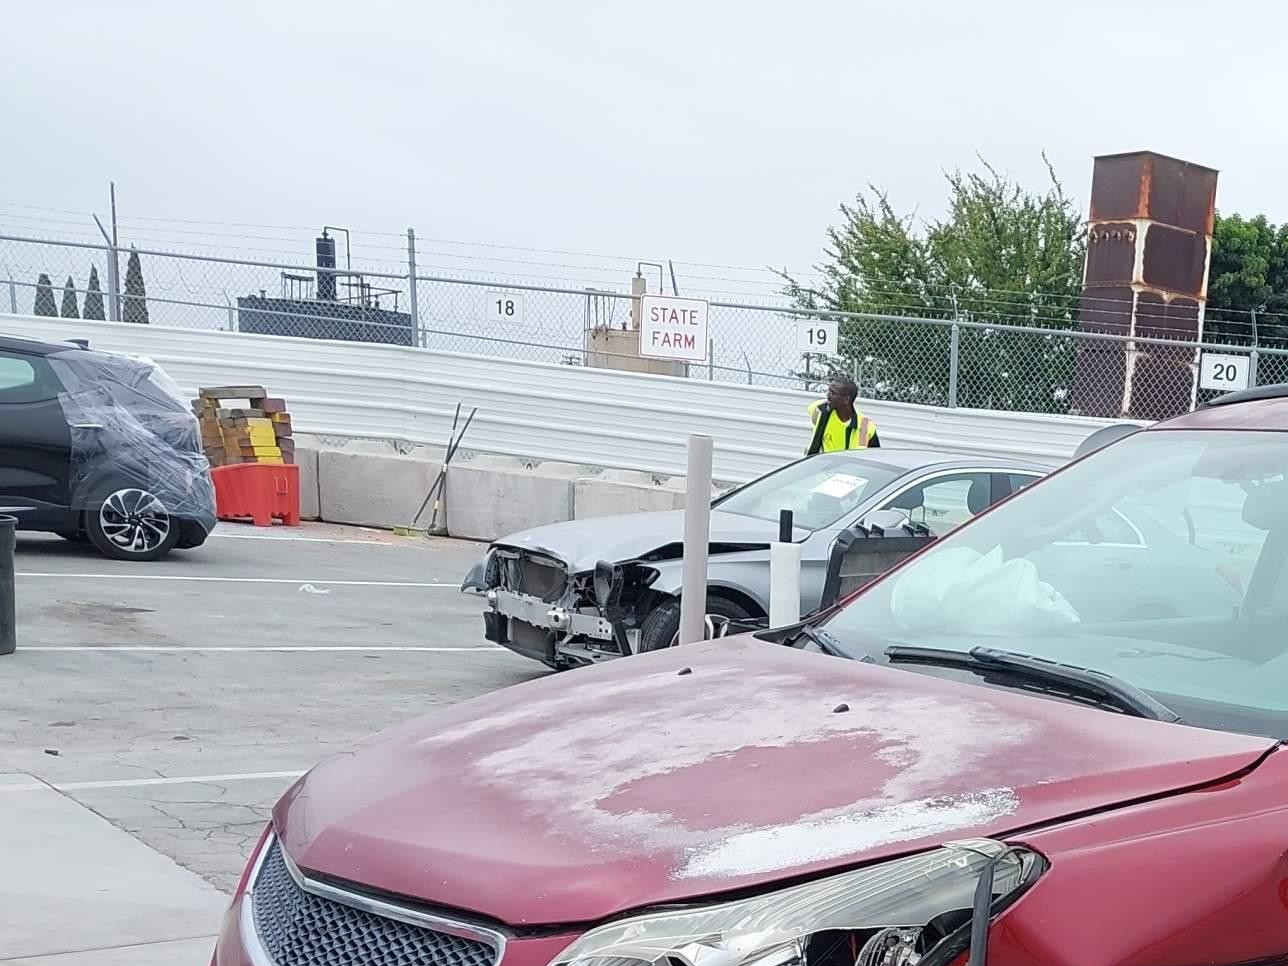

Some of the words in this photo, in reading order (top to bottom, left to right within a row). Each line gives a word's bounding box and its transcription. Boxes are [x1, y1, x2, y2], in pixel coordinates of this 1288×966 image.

[495, 299, 515, 316] 18
[650, 306, 699, 325] STATE
[651, 330, 696, 350] FARM
[806, 327, 827, 345] 19
[1212, 363, 1237, 382] 20
